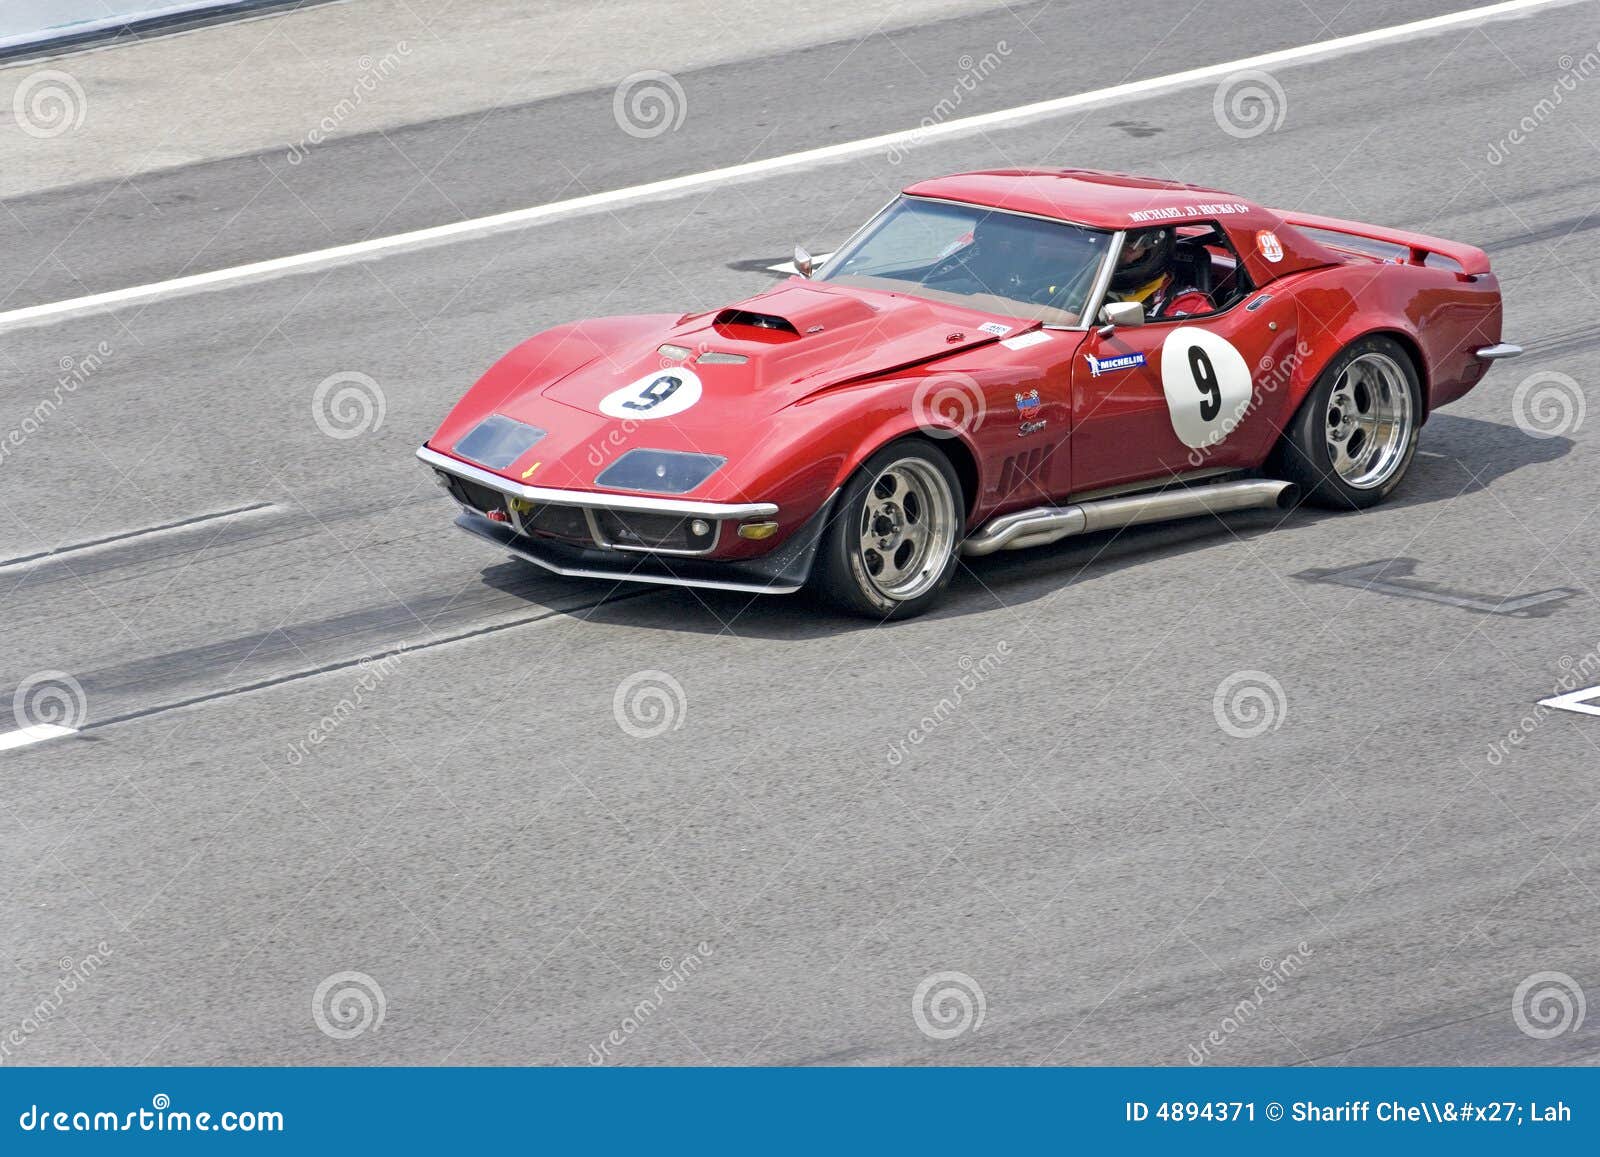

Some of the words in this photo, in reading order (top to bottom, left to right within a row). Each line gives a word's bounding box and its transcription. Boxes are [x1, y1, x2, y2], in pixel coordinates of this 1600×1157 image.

[1128, 207, 1186, 222] MICHAEL
[1100, 355, 1143, 370] MICHELIN
[622, 376, 682, 411] 9
[1188, 345, 1221, 421] 9
